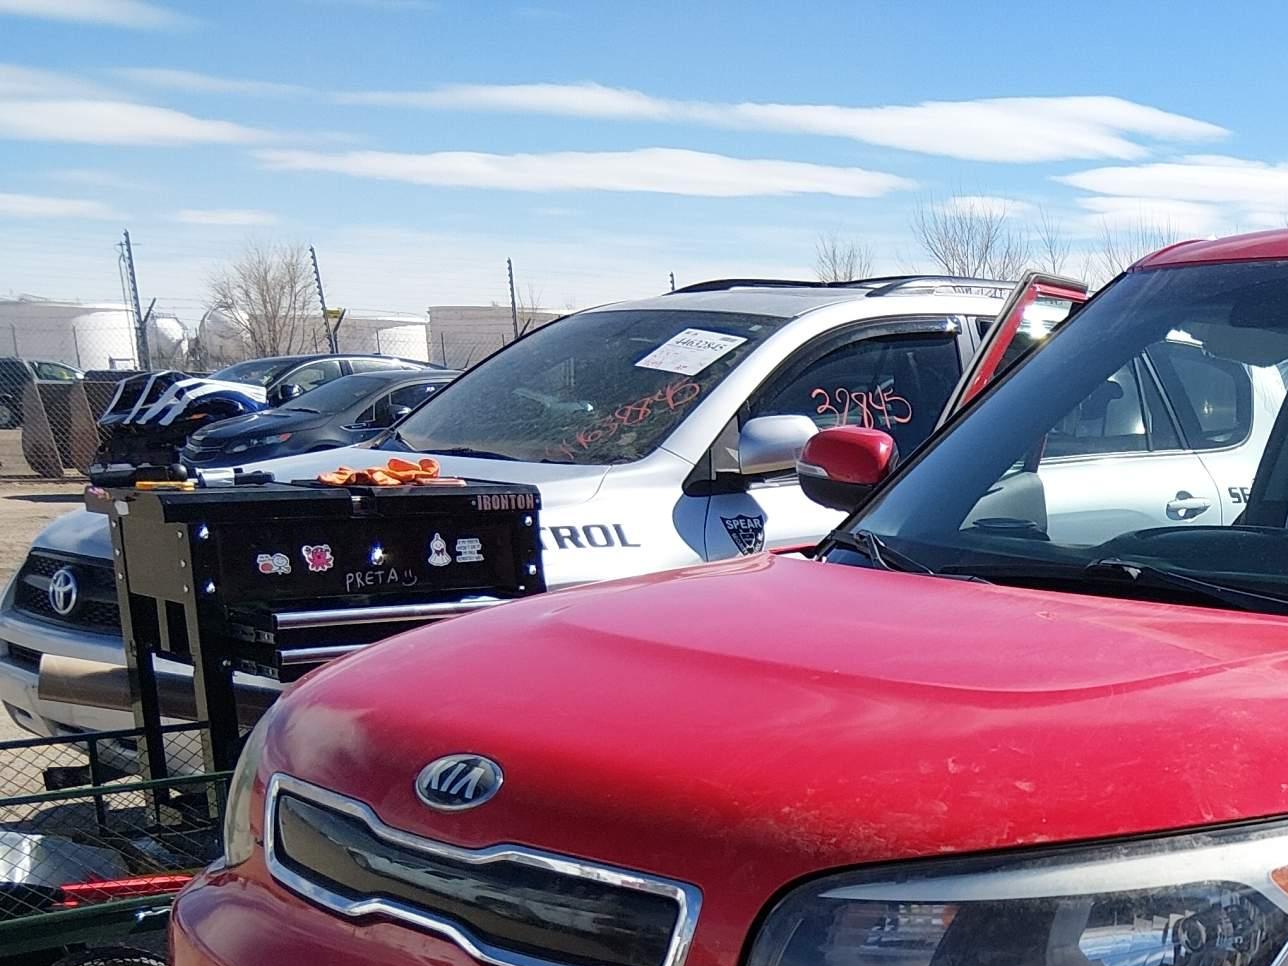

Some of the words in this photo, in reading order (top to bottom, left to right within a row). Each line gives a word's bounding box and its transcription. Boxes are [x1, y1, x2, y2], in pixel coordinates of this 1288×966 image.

[477, 494, 534, 511] IRONTON
[725, 518, 763, 535] SPEAR
[346, 567, 399, 593] PRETA
